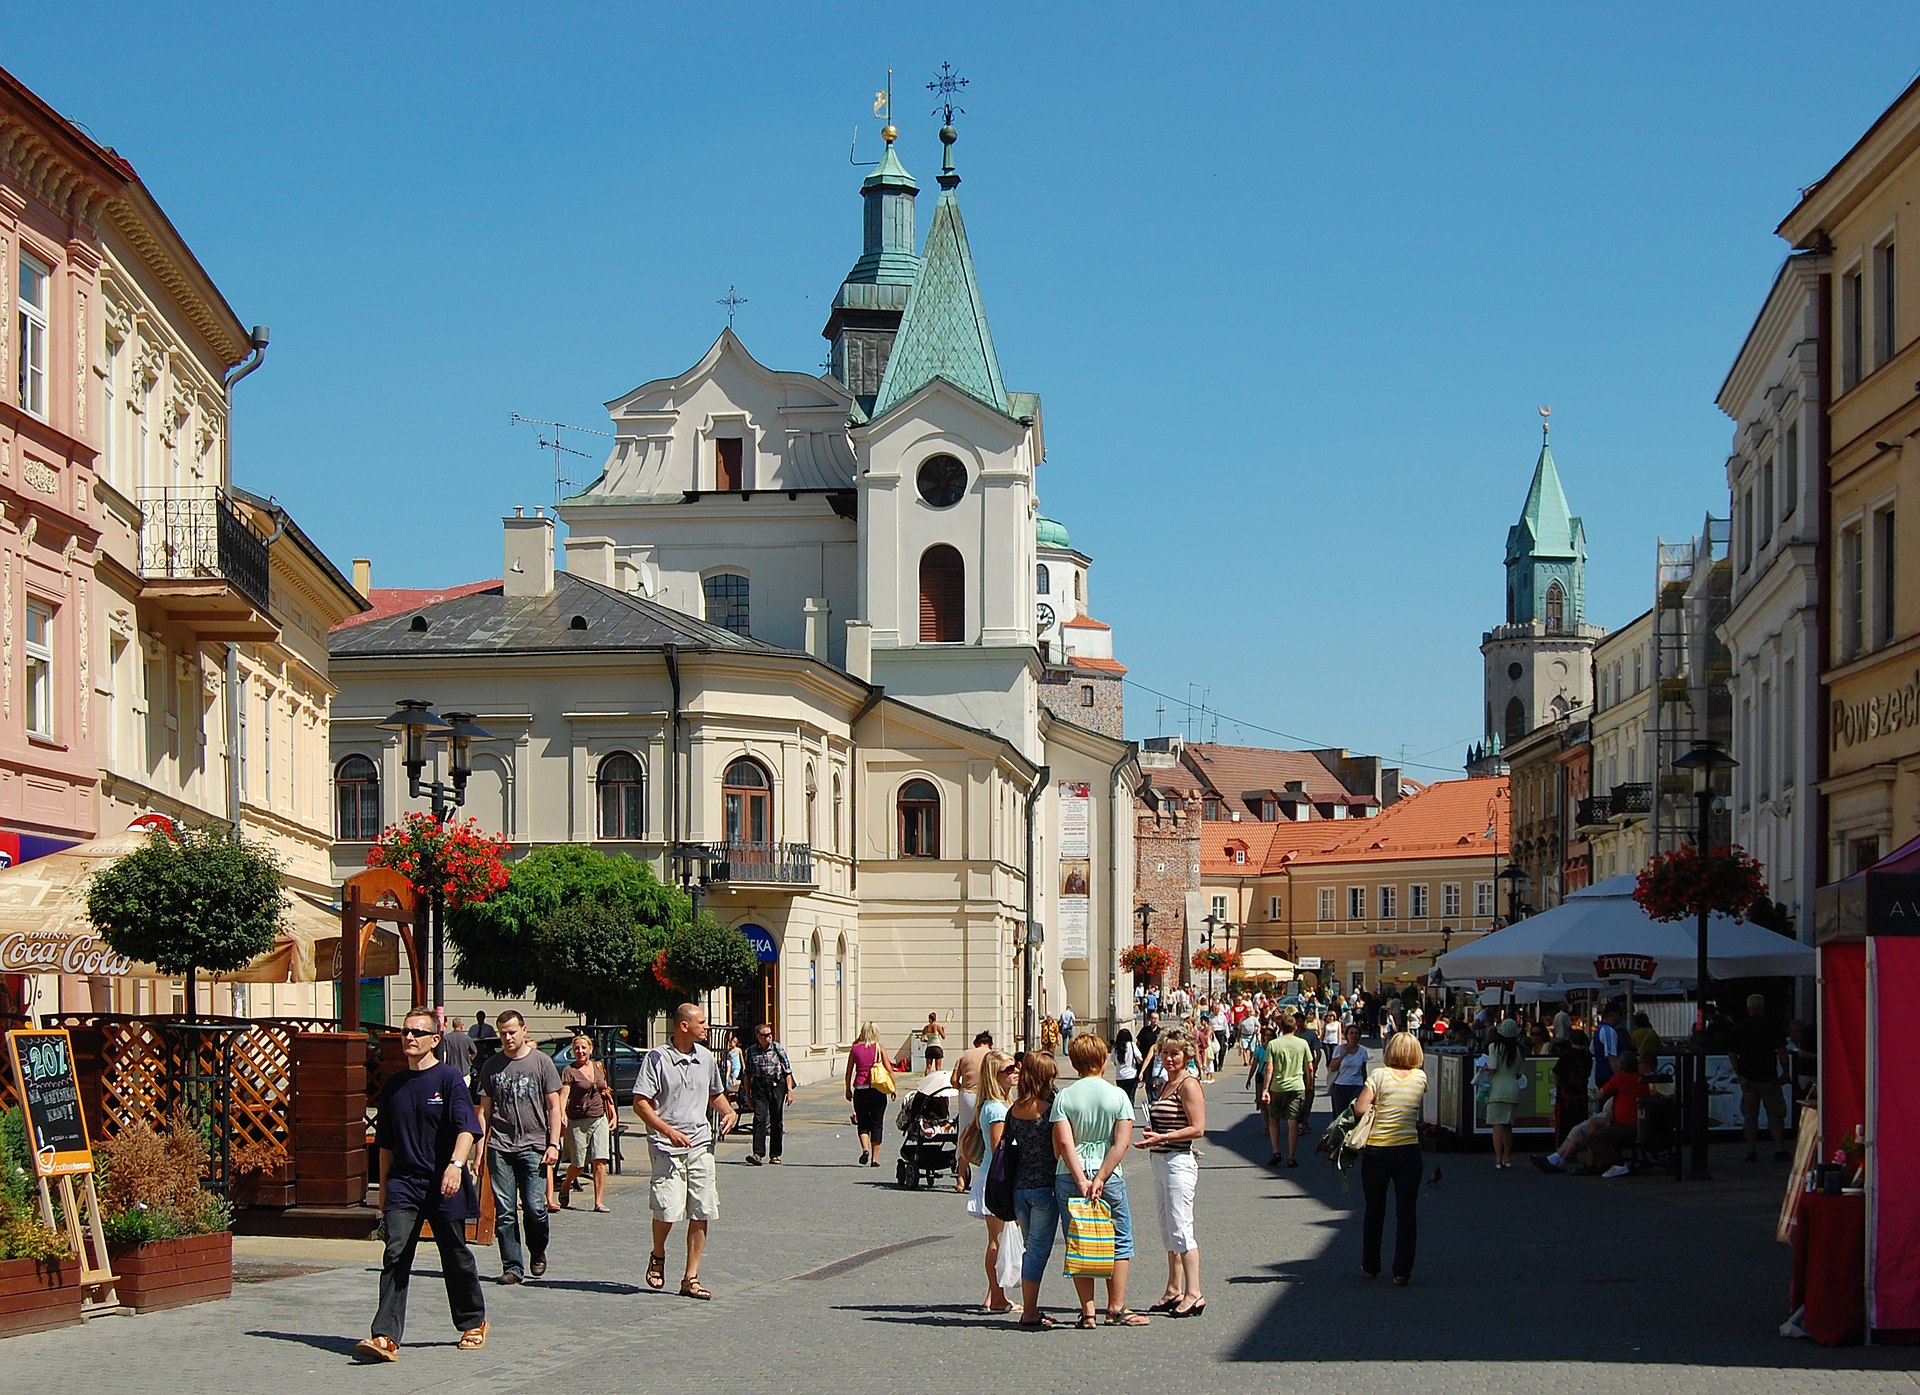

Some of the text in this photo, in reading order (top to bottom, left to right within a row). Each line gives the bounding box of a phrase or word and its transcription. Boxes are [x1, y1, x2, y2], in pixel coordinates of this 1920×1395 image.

[29, 931, 71, 940] DRINK
[1602, 955, 1649, 972] ŻYWIEC
[28, 1088, 41, 1104] NA
